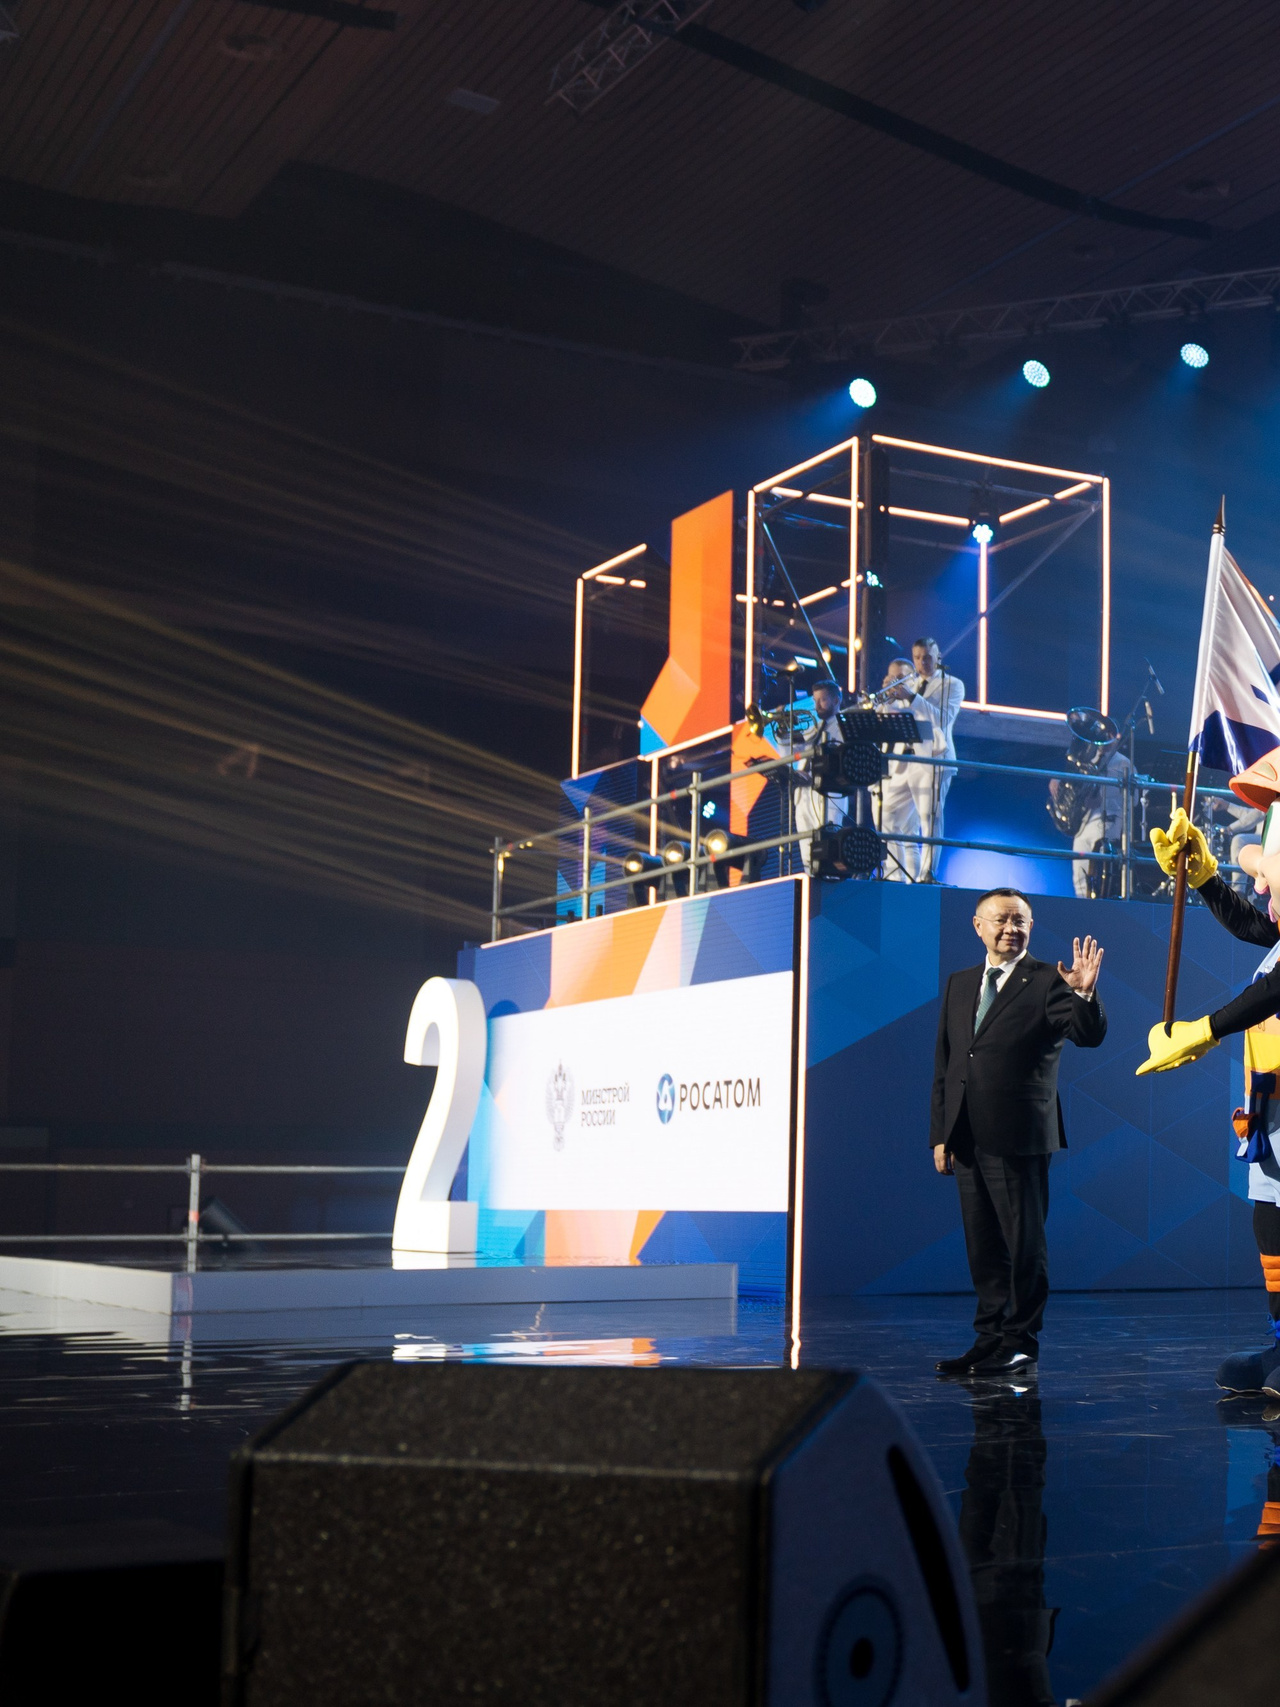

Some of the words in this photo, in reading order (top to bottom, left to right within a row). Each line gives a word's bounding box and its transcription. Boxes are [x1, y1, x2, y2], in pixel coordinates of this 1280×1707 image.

[581, 1083, 630, 1106] МИНСТРОЙ
[679, 1077, 761, 1112] РОСАТОМ
[393, 976, 488, 1253] 2
[581, 1109, 616, 1127] РОССИИ
